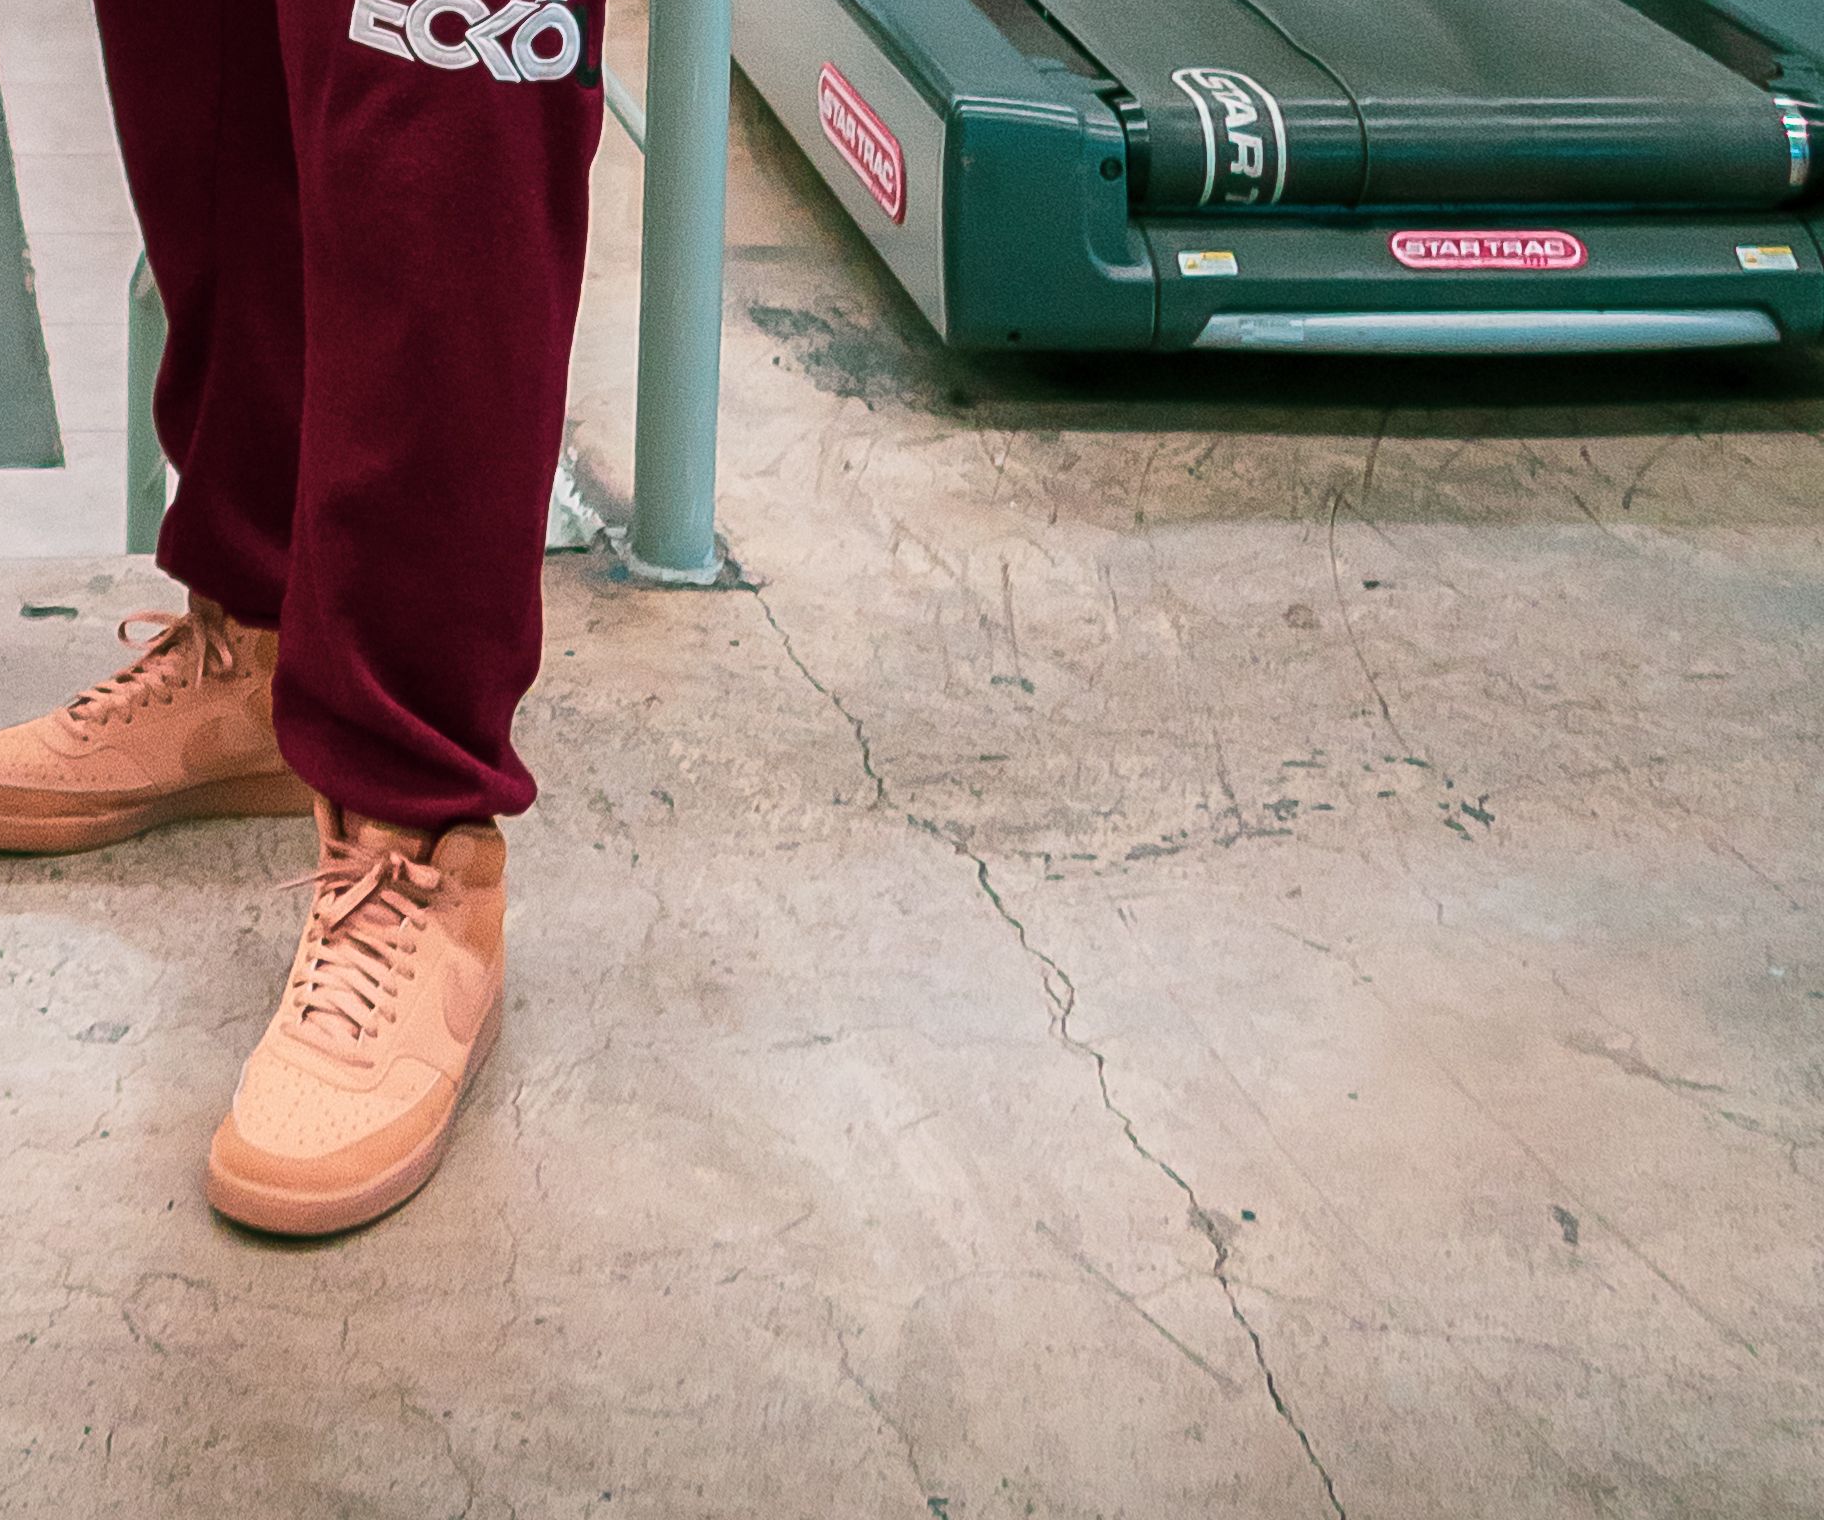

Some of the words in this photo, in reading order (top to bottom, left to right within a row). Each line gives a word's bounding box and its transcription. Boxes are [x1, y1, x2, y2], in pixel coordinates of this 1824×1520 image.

[823, 88, 857, 150] STAR
[856, 125, 895, 194] TRAC
[1404, 239, 1480, 258] STAR
[1483, 239, 1566, 258] TRAC
